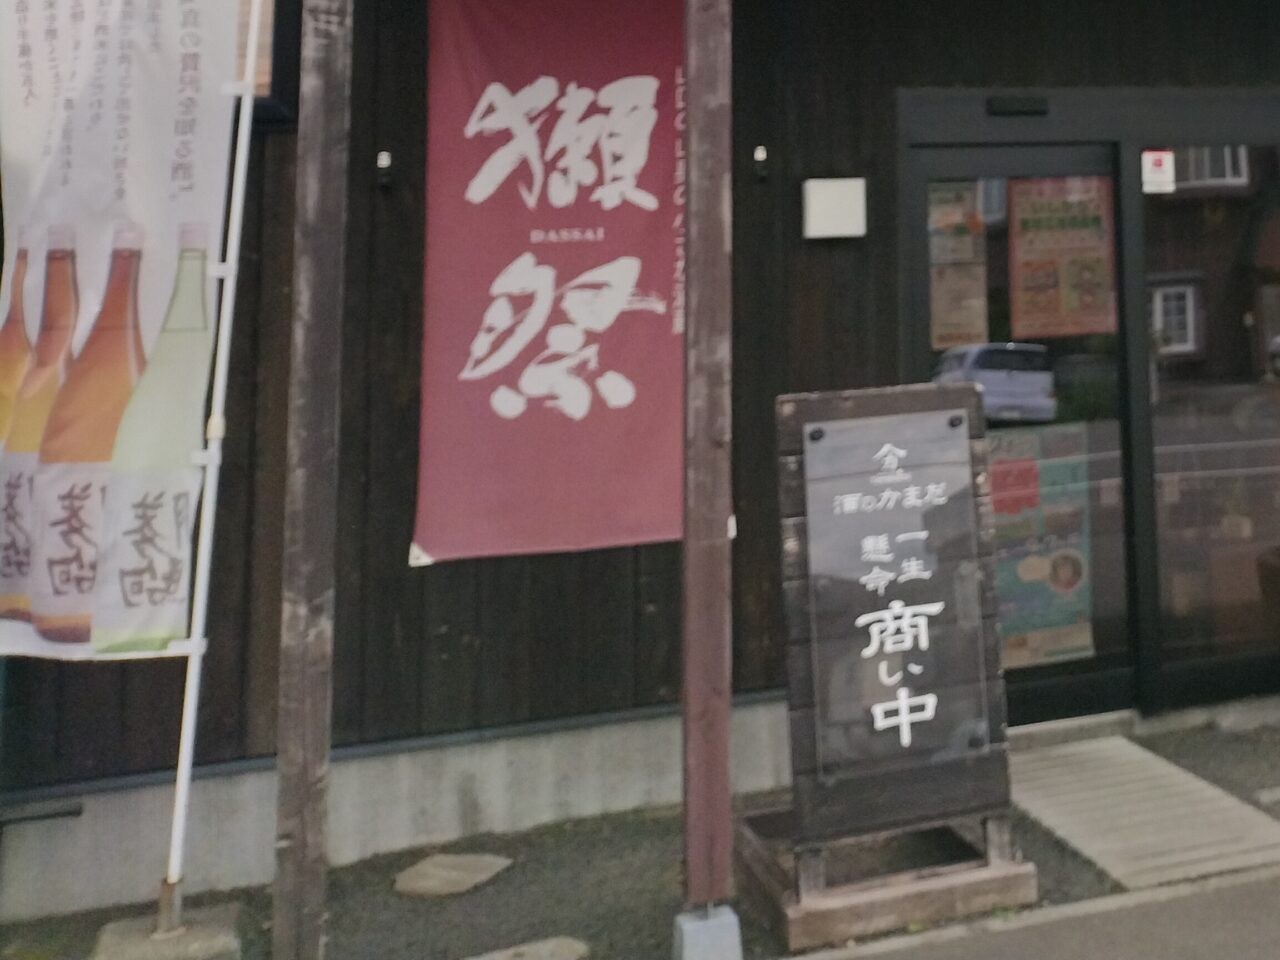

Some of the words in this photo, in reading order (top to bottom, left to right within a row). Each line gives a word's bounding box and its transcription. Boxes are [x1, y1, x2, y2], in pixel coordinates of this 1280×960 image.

[833, 482, 948, 515] 酒のかまだ
[855, 600, 945, 747] 商い中
